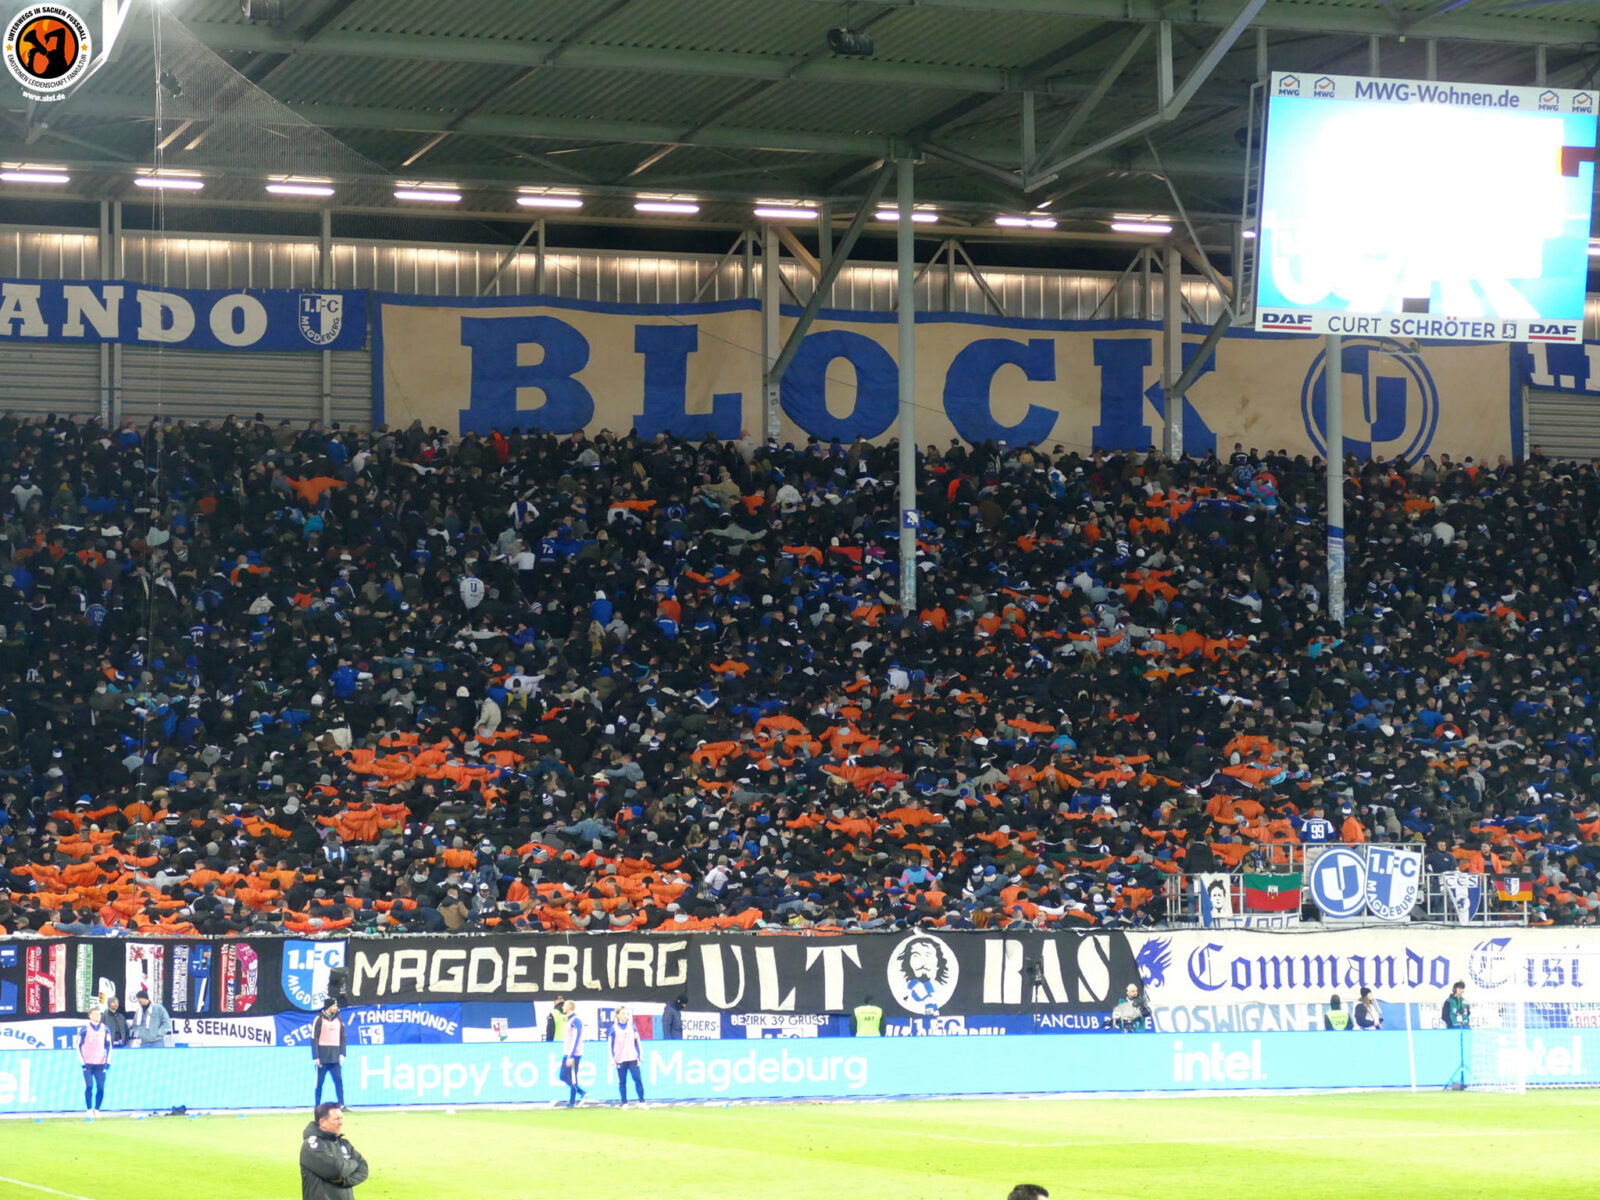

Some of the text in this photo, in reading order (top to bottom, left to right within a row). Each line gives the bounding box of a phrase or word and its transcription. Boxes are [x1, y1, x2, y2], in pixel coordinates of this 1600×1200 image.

[1313, 90, 1335, 98] MWG
[1355, 80, 1520, 108] MWG-Wohnen.de
[1538, 104, 1559, 112] MWG
[302, 298, 339, 313] 1.FC
[301, 315, 340, 342] MAGDEBURG
[1262, 313, 1313, 324] DAF
[1328, 316, 1495, 338] CURT SCHRÖTER
[1528, 323, 1577, 335] DAF
[459, 315, 1216, 460] BLOCK
[1311, 824, 1325, 839] 99
[1371, 853, 1417, 878] 1.FC
[1366, 879, 1416, 919] MAGDEBURG
[287, 948, 340, 970] 1.FC
[353, 941, 687, 997] MAGDEBURG
[1187, 941, 1450, 991] Commando
[357, 1009, 458, 1036] TANGERMÜNDE
[731, 1014, 767, 1026] BEZIRK
[771, 1015, 785, 1026] 39
[1033, 1014, 1100, 1029] FANCLUB
[0, 1027, 46, 1048] auer
[183, 1019, 193, 1034] &
[196, 1019, 272, 1045] SEEHAUSEN
[359, 1055, 491, 1097] Happy
[500, 1058, 539, 1089] to
[650, 1048, 868, 1090] Magdeburg
